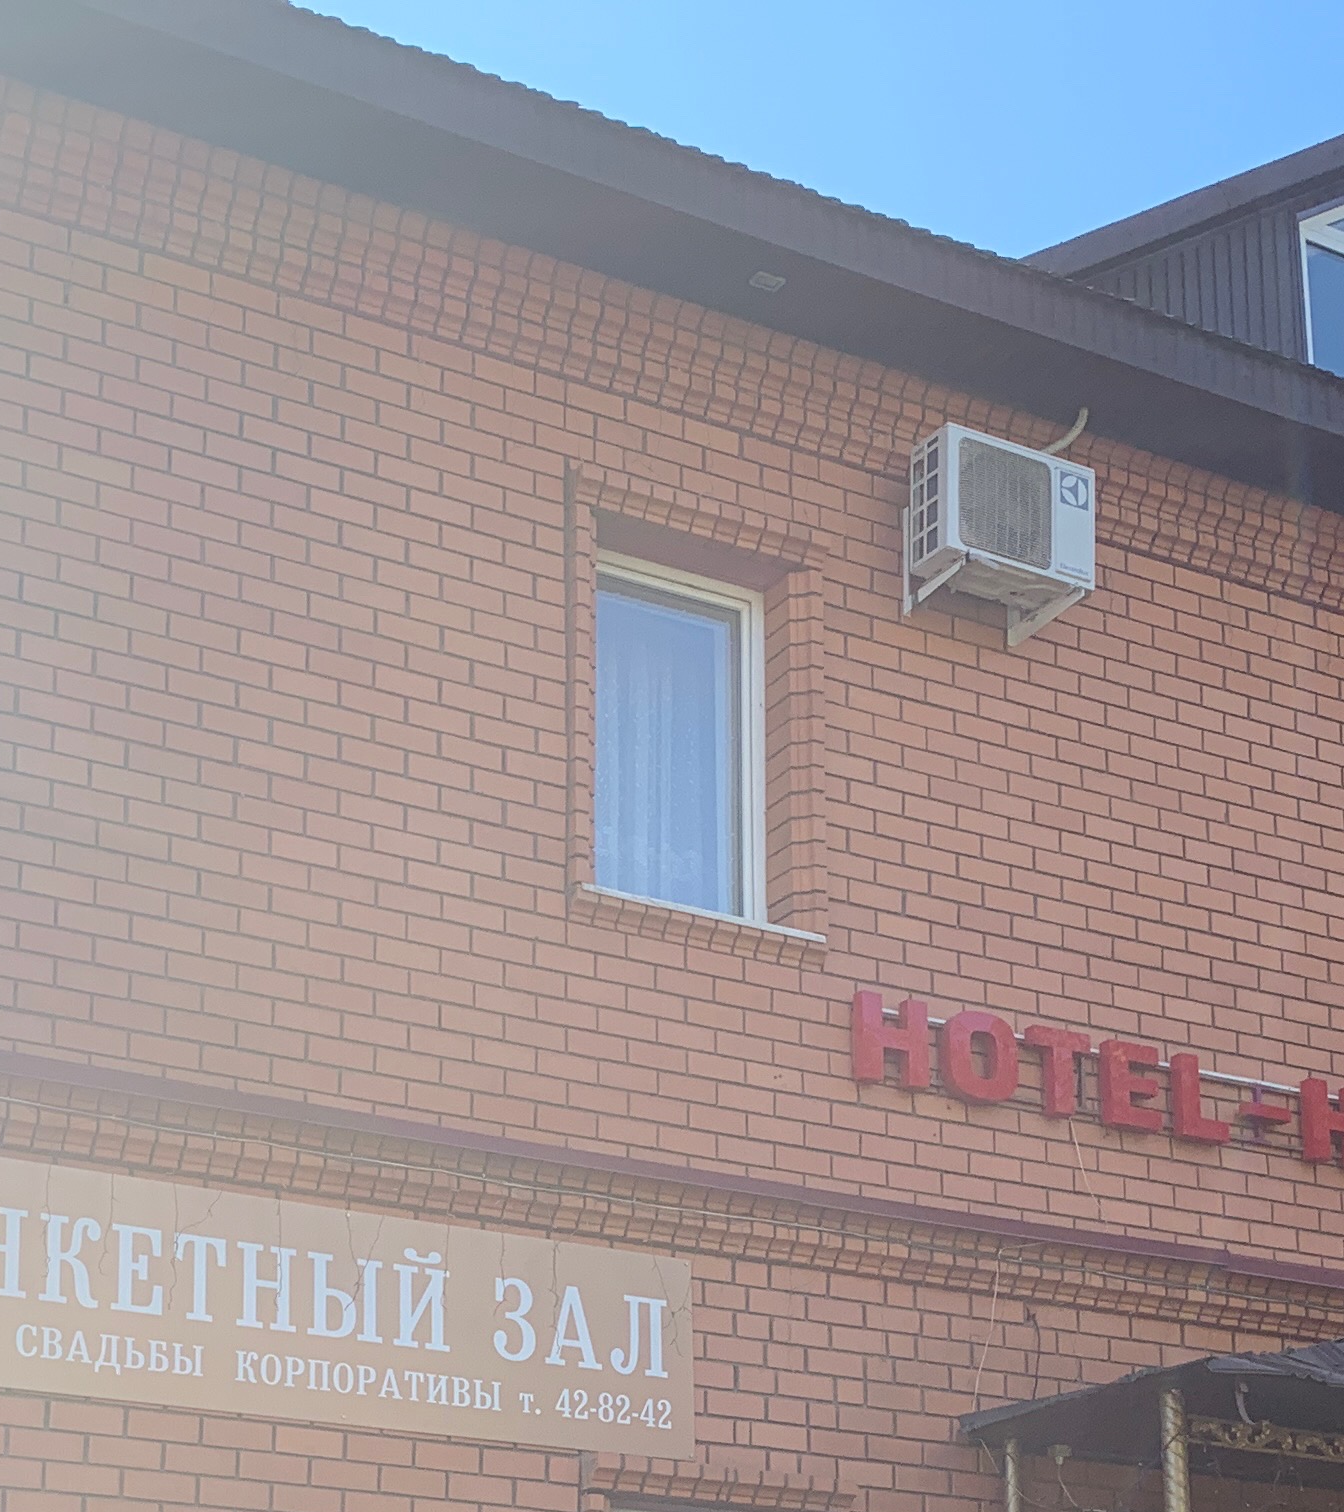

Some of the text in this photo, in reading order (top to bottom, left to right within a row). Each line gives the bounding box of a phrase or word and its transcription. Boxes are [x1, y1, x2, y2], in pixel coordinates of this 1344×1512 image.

[15, 1324, 205, 1378] СВАДЬБЫ
[234, 1350, 502, 1412] КОРПОРАТИВЫ
[556, 1388, 673, 1431] 42-82-42
[493, 1277, 669, 1379] ЗАЛ
